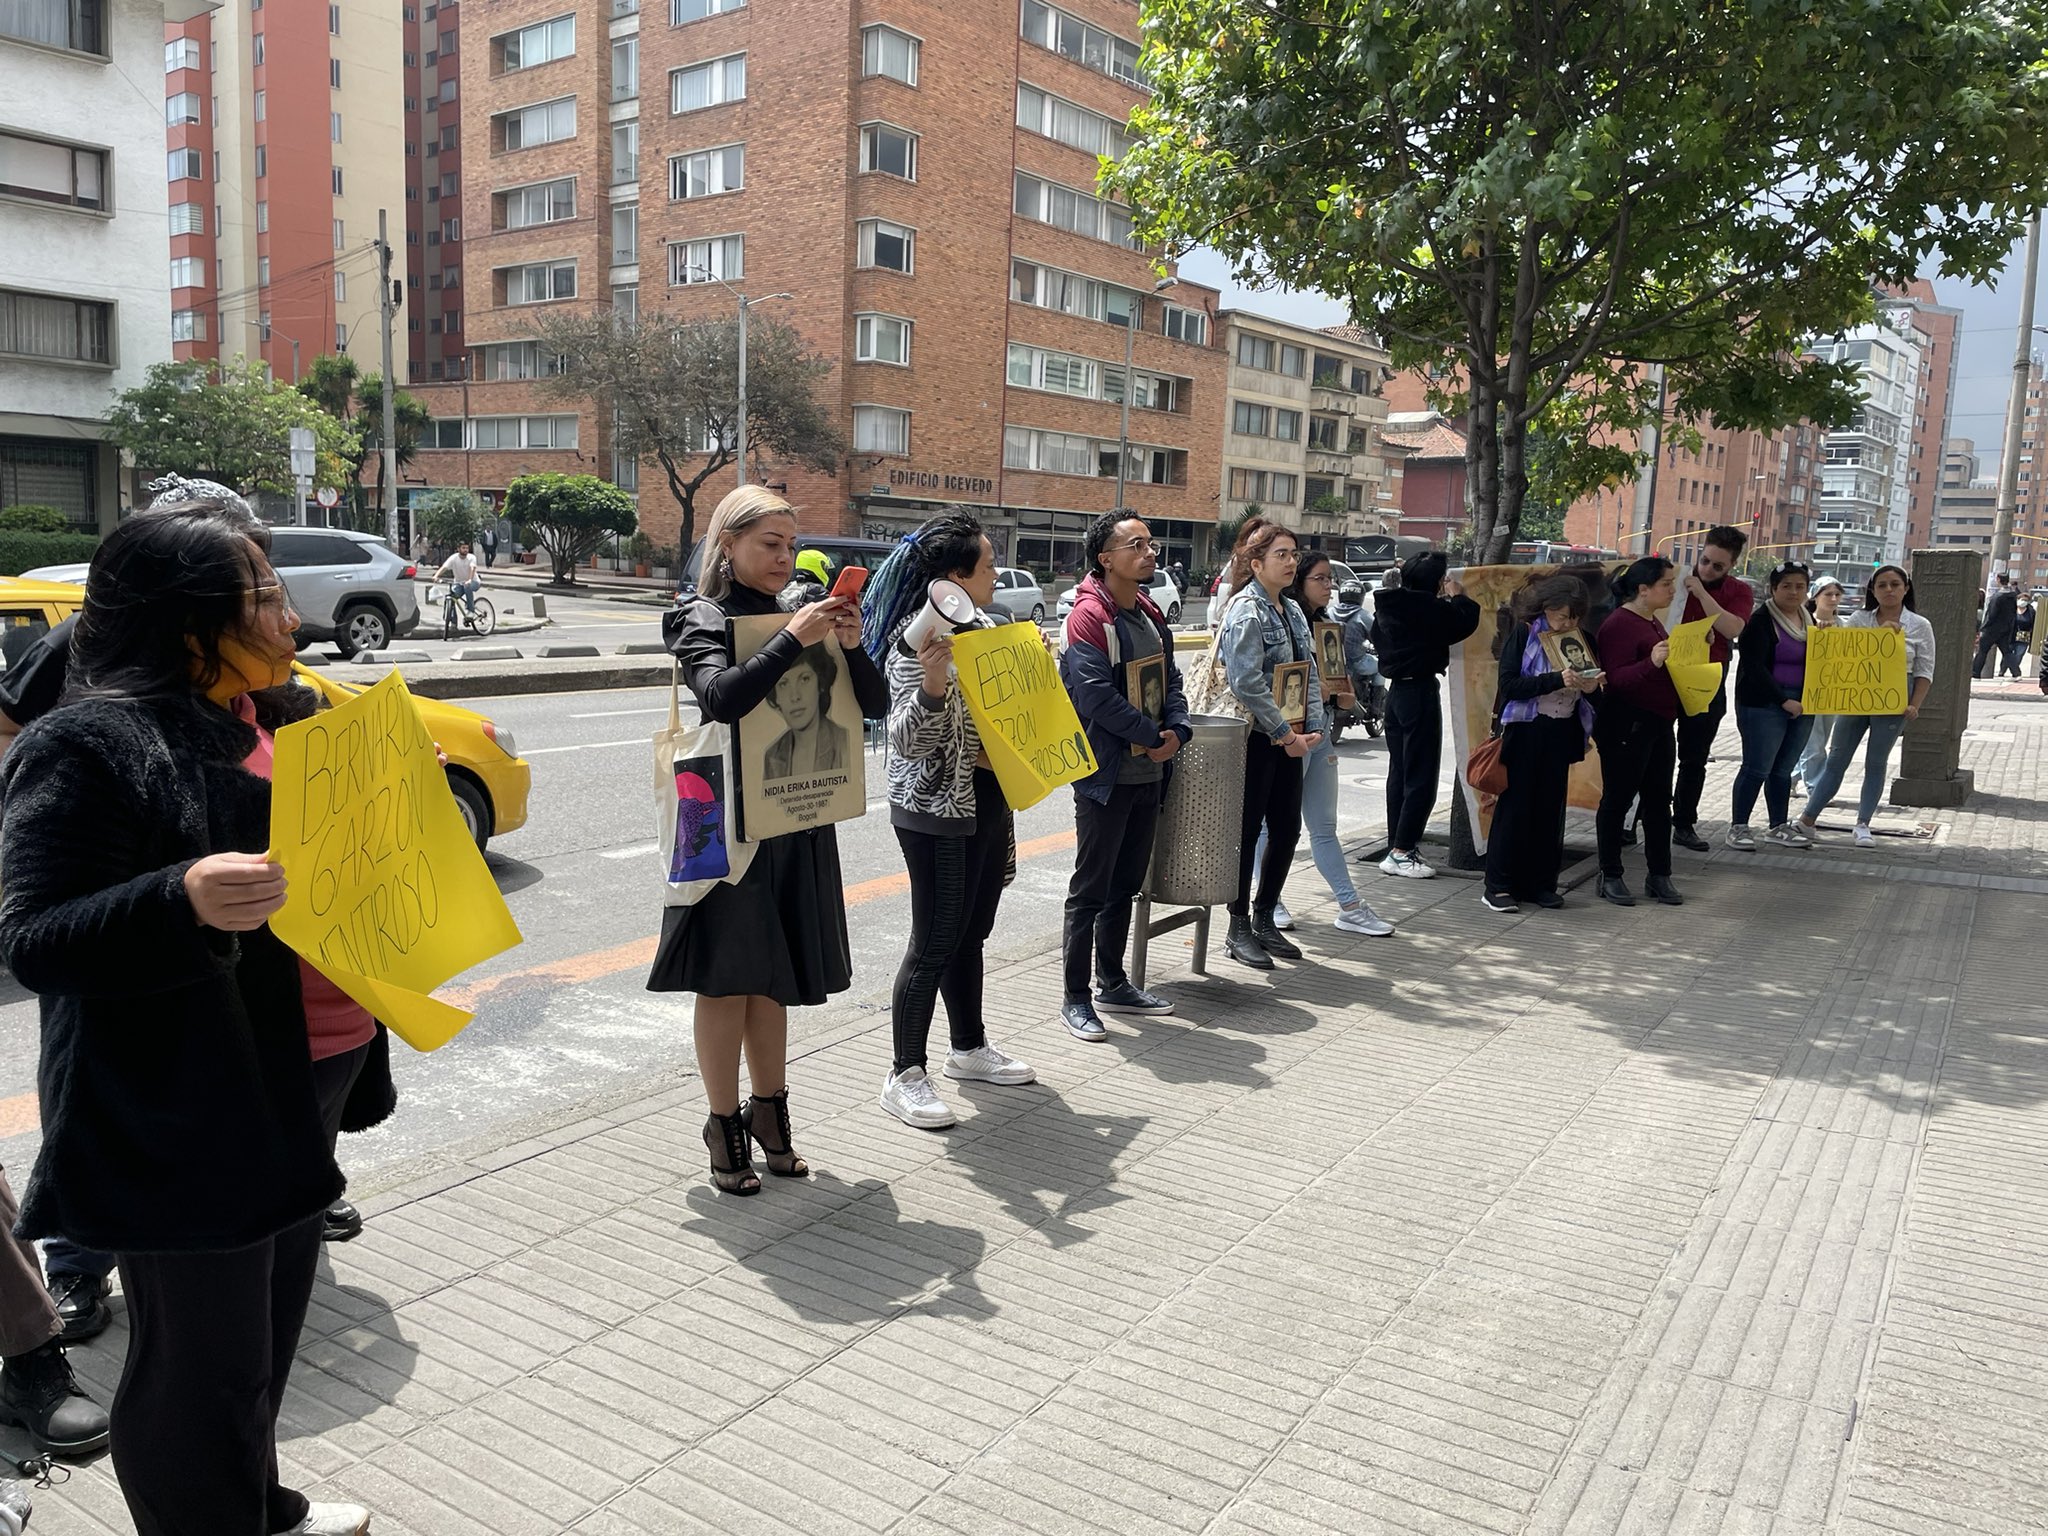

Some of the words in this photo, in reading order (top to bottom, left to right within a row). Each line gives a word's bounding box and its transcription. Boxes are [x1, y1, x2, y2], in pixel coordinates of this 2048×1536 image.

[889, 469, 939, 488] EDIFICIO
[1812, 631, 1897, 660] BERNARDO
[1806, 686, 1901, 712] MENTIROSO
[301, 683, 426, 846] BERNARDO
[764, 786, 785, 797] NIDIA
[787, 780, 810, 793] ERIKA
[812, 775, 848, 789] BAUTISTA
